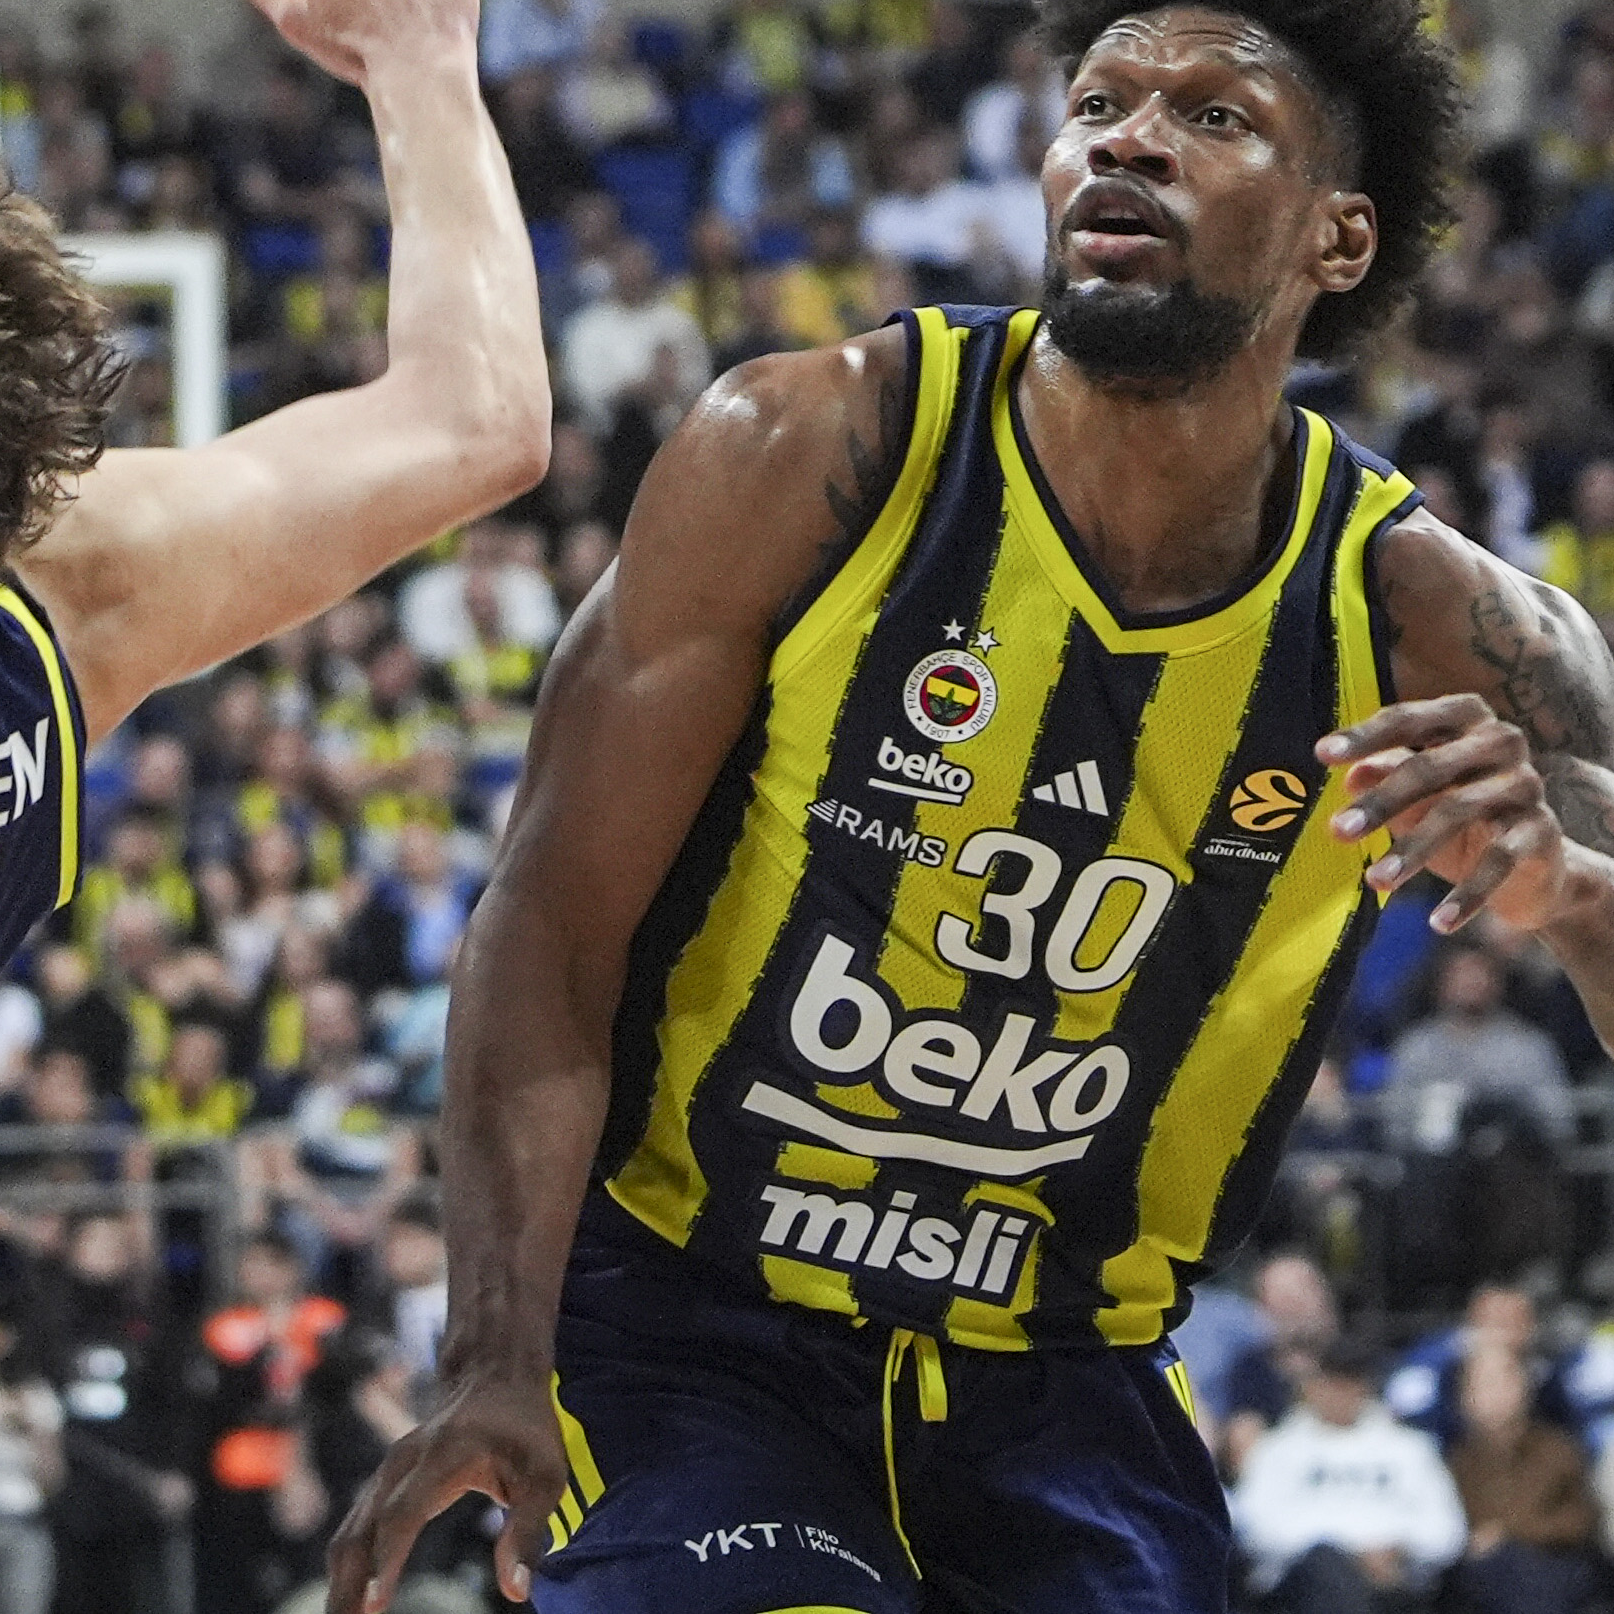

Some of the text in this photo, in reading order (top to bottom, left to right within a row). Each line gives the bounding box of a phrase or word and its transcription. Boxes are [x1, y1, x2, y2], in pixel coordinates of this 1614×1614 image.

[961, 654, 990, 683] SPOR
[877, 736, 972, 793] beko
[835, 803, 947, 867] RAMS
[1204, 844, 1283, 864] abu dhabi
[935, 827, 1178, 994] 30
[790, 933, 1131, 1134] beko
[760, 1183, 1029, 1295] misli
[685, 1522, 782, 1563] YKT
